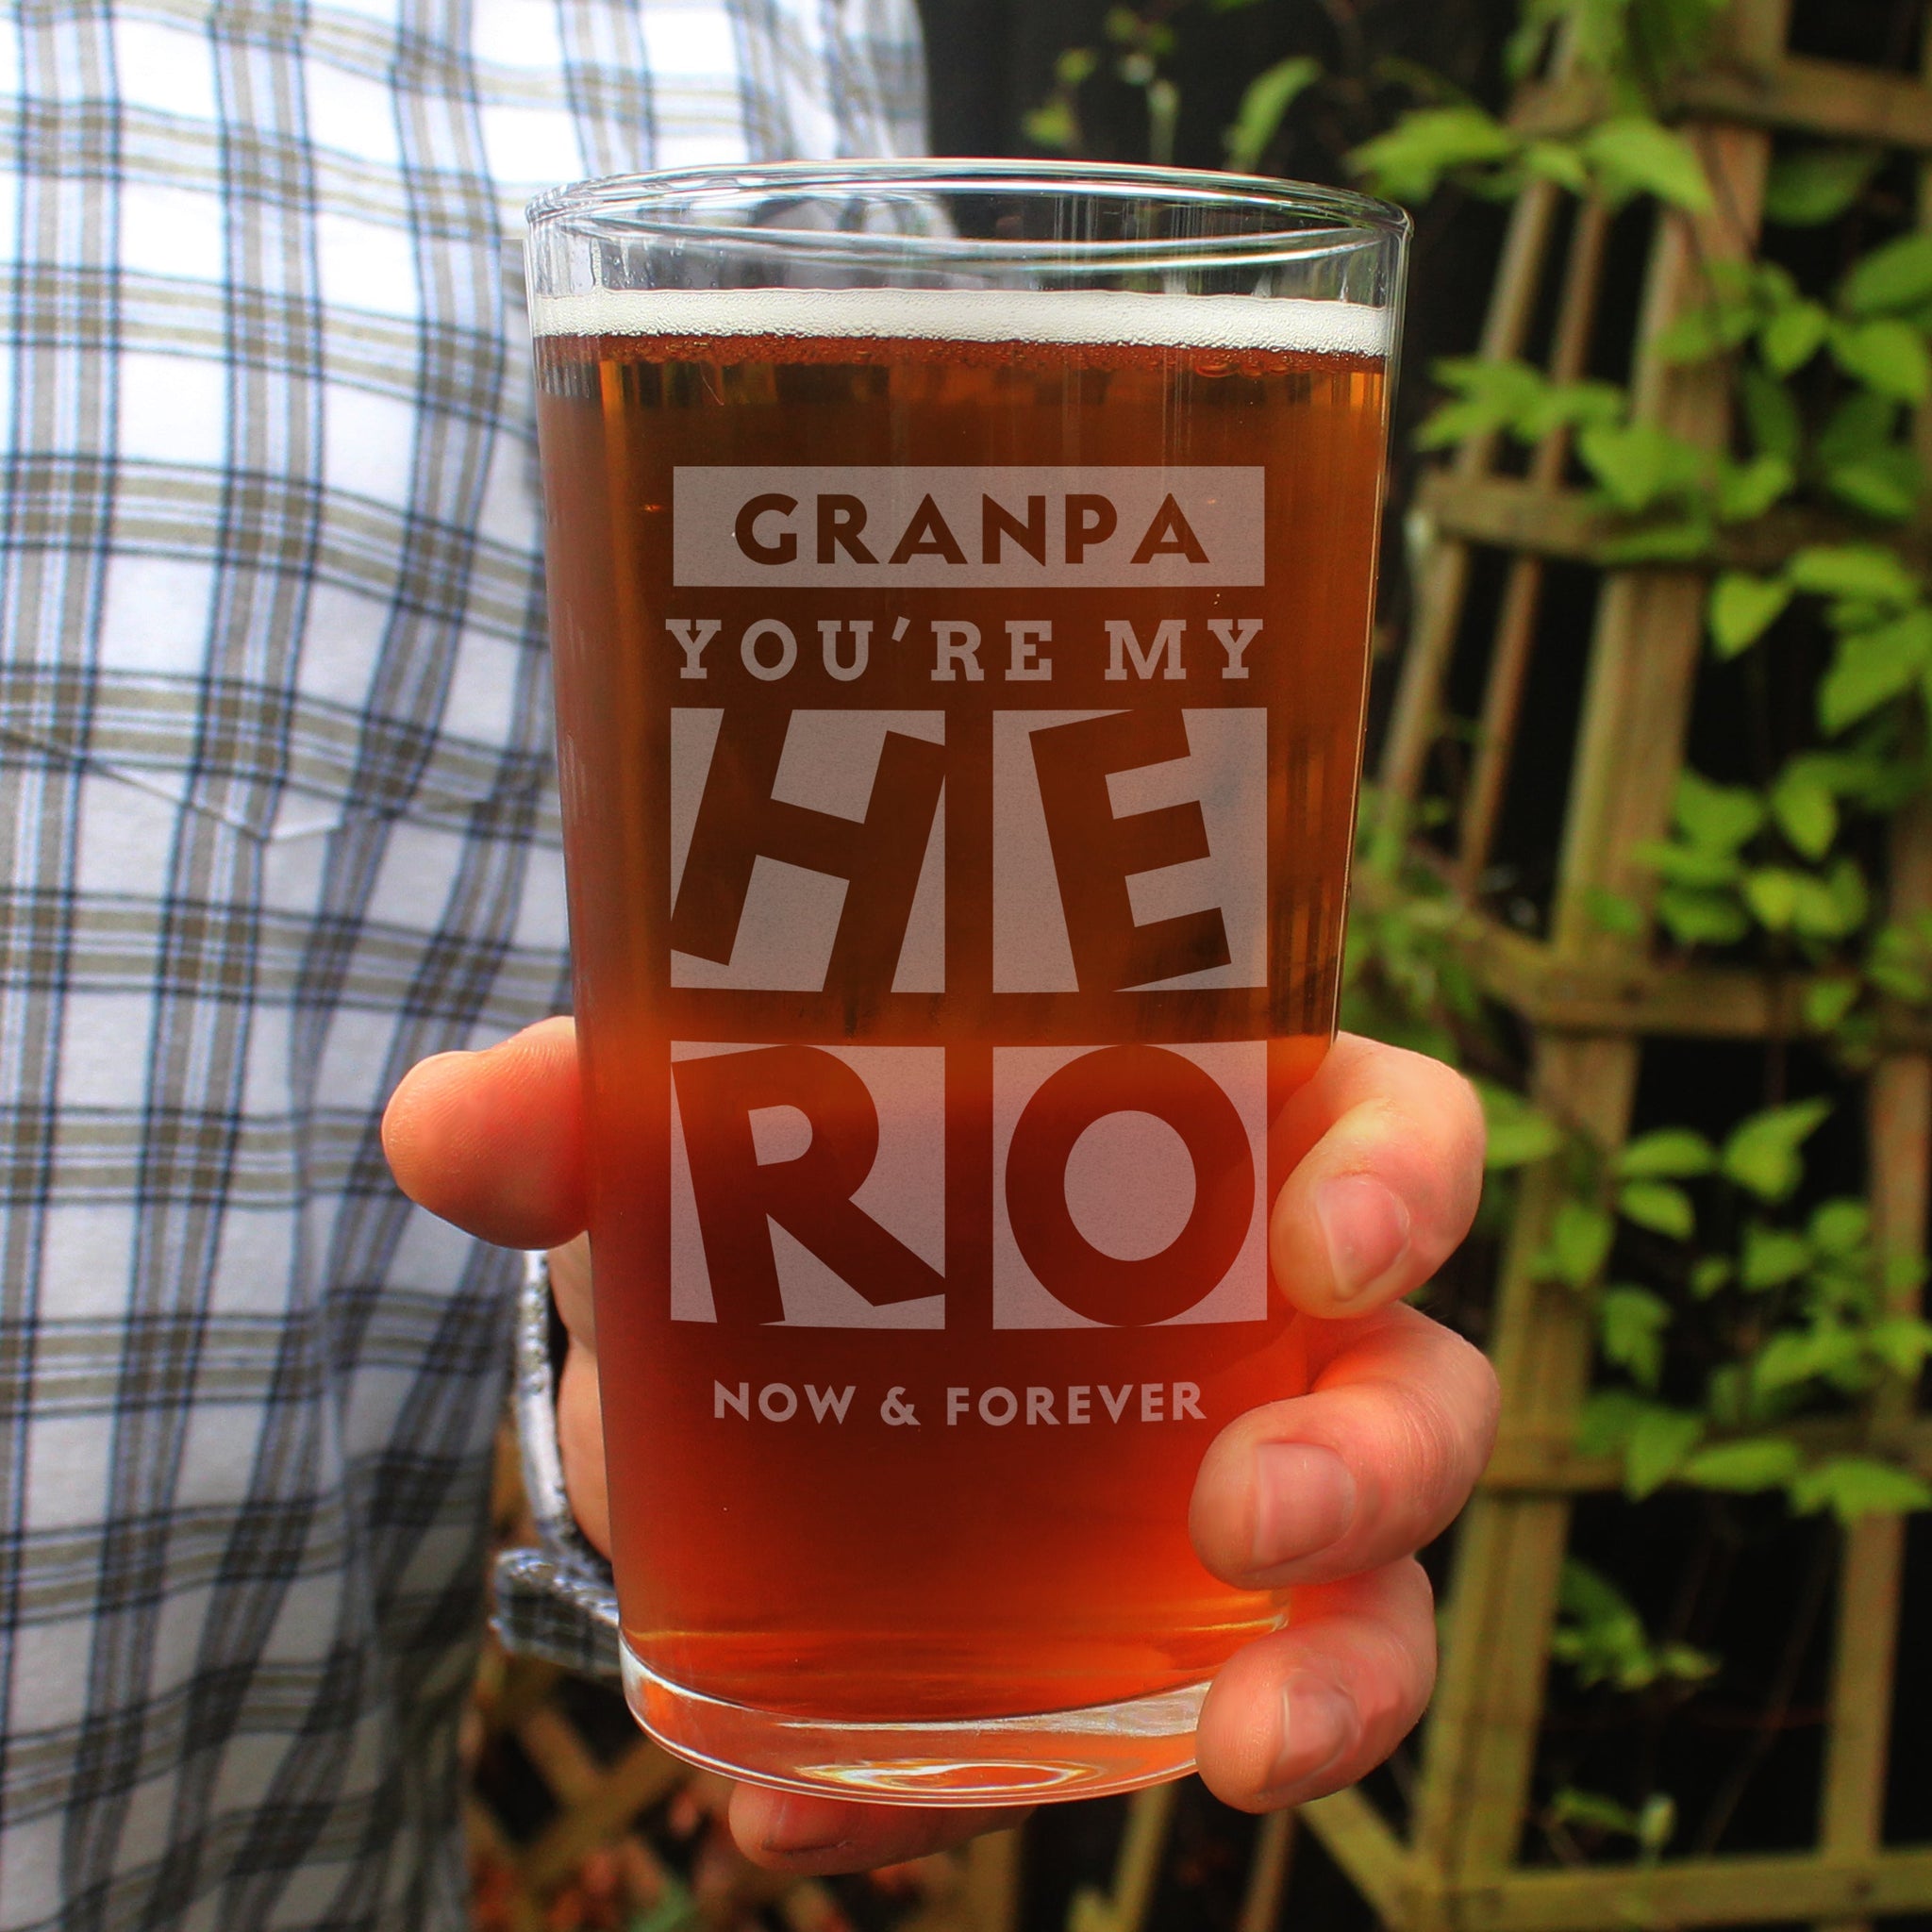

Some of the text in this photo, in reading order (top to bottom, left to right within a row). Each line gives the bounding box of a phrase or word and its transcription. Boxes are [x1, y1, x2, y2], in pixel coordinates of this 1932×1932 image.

[735, 492, 1210, 567] GRANPA
[665, 615, 1263, 681] YOU'RE MY
[713, 1379, 1207, 1426] NOW & FOREVER
